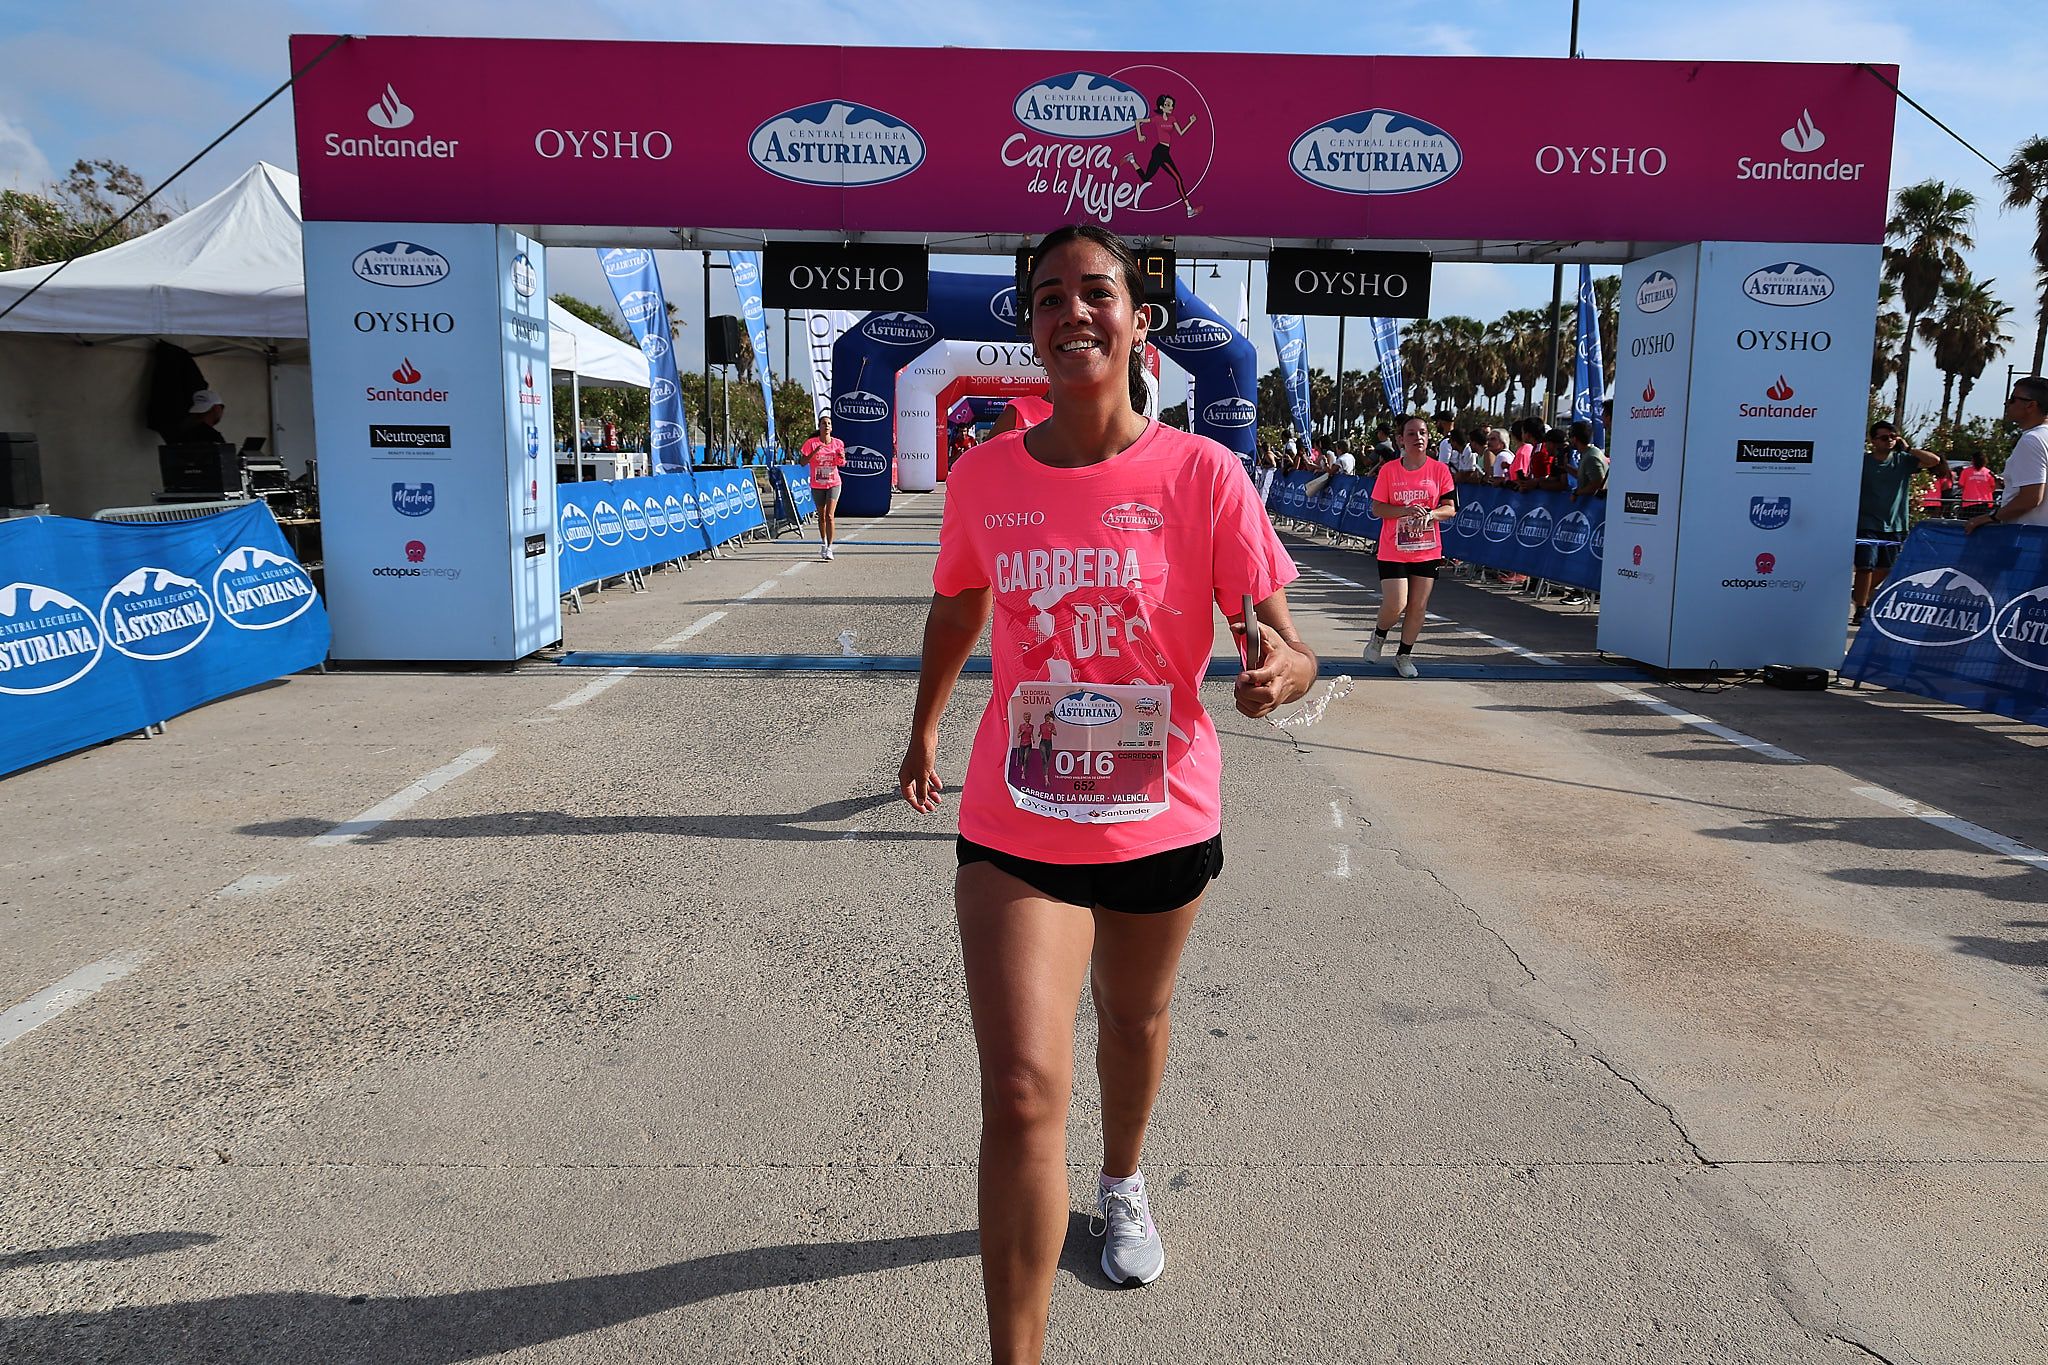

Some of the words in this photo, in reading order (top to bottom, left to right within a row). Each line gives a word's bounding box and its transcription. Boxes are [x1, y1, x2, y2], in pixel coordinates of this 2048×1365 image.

[1044, 94, 1088, 102] CENTRAL
[1091, 94, 1135, 102] LECHERA
[1023, 95, 1138, 122] ASTURIANA
[534, 128, 673, 160] OYSHO
[789, 130, 845, 139] CENTRAL
[850, 131, 906, 140] LECHERA
[1329, 139, 1384, 147] CENTRAL
[1389, 139, 1444, 148] LECHERA
[325, 133, 459, 158] Santander
[762, 131, 912, 165] ASTURIANA
[1000, 132, 1112, 169] Carrera
[1302, 140, 1449, 173] ASTURIANA
[1535, 145, 1667, 176] OYSHO
[1736, 156, 1865, 181] Santander
[1027, 170, 1048, 194] de
[1052, 170, 1068, 194] la
[1064, 167, 1152, 223] Mujer
[360, 257, 444, 276] ASTURIANA
[789, 265, 904, 292] OYSHO
[1294, 269, 1408, 298] OYSHO
[1748, 277, 1828, 296] ASTURIANA
[1638, 288, 1674, 306] ASTURIANA
[353, 311, 455, 334] OYSHO
[511, 316, 540, 343] OYSHO
[867, 322, 929, 339] ASTURIANA
[1165, 331, 1228, 345] ASTURIANA
[1631, 332, 1675, 358] OYSHO
[1736, 329, 1832, 352] OYSHO
[970, 375, 1001, 385] Sports
[366, 387, 449, 402] Santander
[836, 400, 886, 416] ASTURIANA
[900, 410, 930, 418] OYSHO
[1629, 404, 1666, 420] Santander
[1739, 403, 1818, 419] Santander
[375, 429, 446, 446] Neutrogena
[900, 452, 930, 460] OYSHO
[1742, 444, 1809, 461] Neutrogena
[846, 460, 884, 470] TURIANA
[394, 489, 433, 508] Marlene
[1393, 490, 1430, 502] CARRERA
[1626, 496, 1657, 513] Neutrogena
[984, 510, 1046, 530] OYSHO
[1106, 512, 1160, 526] ASTURIANA
[1751, 503, 1789, 521] Marlene
[995, 546, 1143, 594] CARRERA
[124, 597, 162, 613] CENTRAL
[223, 577, 312, 616] ASTURIANA
[1903, 590, 1941, 602] CENTRAL
[1875, 590, 1979, 633] ASTURIANA
[0, 619, 37, 637] ENTRAL
[38, 611, 84, 629] LECHERA
[112, 601, 209, 646] ASTURIANA
[1070, 602, 1121, 660] DE
[0, 626, 98, 673] STURIANA
[1022, 695, 1052, 705] SUMA
[1057, 704, 1118, 718] ASTURIANA
[1055, 751, 1115, 776] 016
[1020, 786, 1055, 801] CARRERA
[1056, 794, 1066, 802] DE
[1078, 794, 1105, 803] MUJER
[1112, 793, 1150, 802] VALENCIA
[1073, 780, 1095, 791] 652
[1021, 797, 1069, 818] OYSHO
[1101, 808, 1150, 818] Santander
